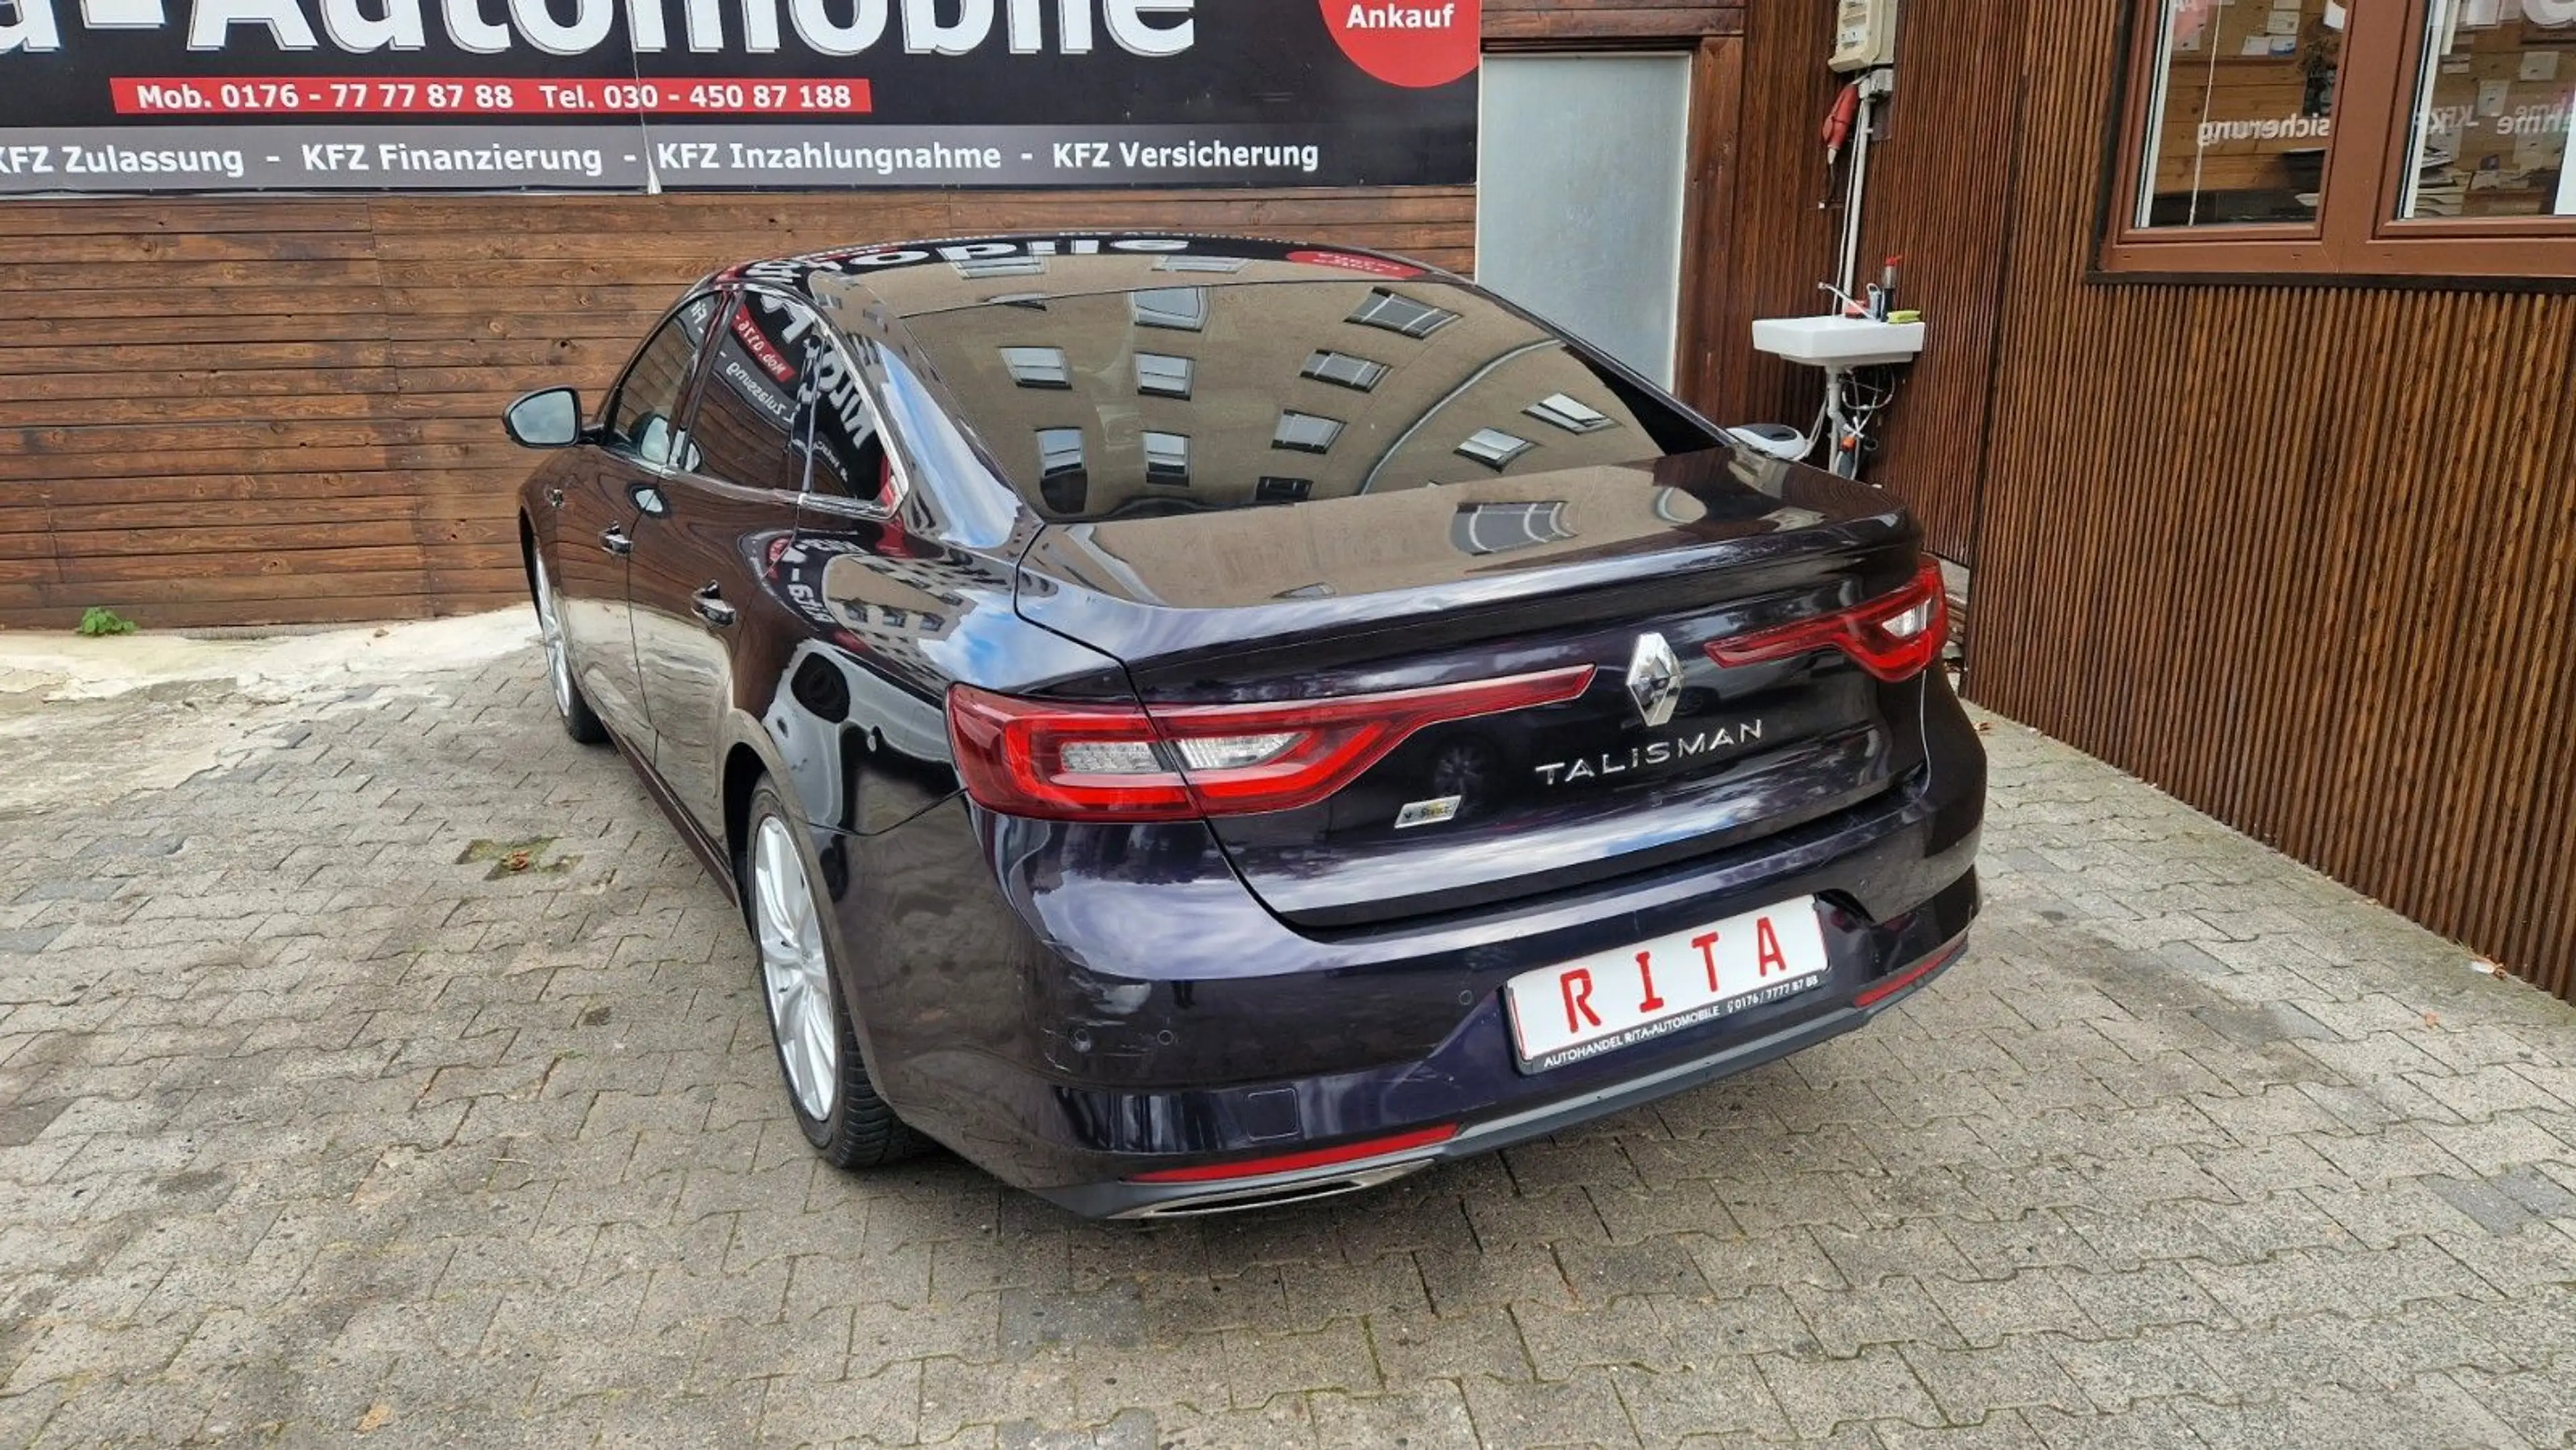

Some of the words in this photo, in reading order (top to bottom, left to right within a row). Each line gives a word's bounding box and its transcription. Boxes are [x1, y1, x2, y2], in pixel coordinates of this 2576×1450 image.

[1346, 3, 1454, 28] Ankauf
[138, 85, 211, 108] Mob.
[221, 85, 299, 108] 0176
[330, 85, 368, 107] 77
[378, 85, 416, 107] 77
[427, 85, 464, 107] 87
[475, 85, 514, 108] 88
[539, 85, 594, 108] Tel.
[604, 85, 659, 108] 030
[690, 85, 744, 108] 450
[753, 85, 787, 108] 87
[800, 85, 851, 108] 188
[61, 144, 244, 177] Zulassung
[301, 144, 370, 170] KFZ
[378, 143, 602, 176] Finanzierung
[657, 143, 720, 170] KFZ
[729, 142, 1002, 172] Inzahlungnahme
[1053, 143, 1110, 168] KFZ
[1119, 140, 1318, 172] Versicherung
[1535, 718, 1763, 787] TALISMAN
[1560, 916, 1788, 1033] RITA
[1544, 1036, 1624, 1068] AUTOHANDEL
[1624, 1005, 1721, 1044] RITA-AUTOMOBILE
